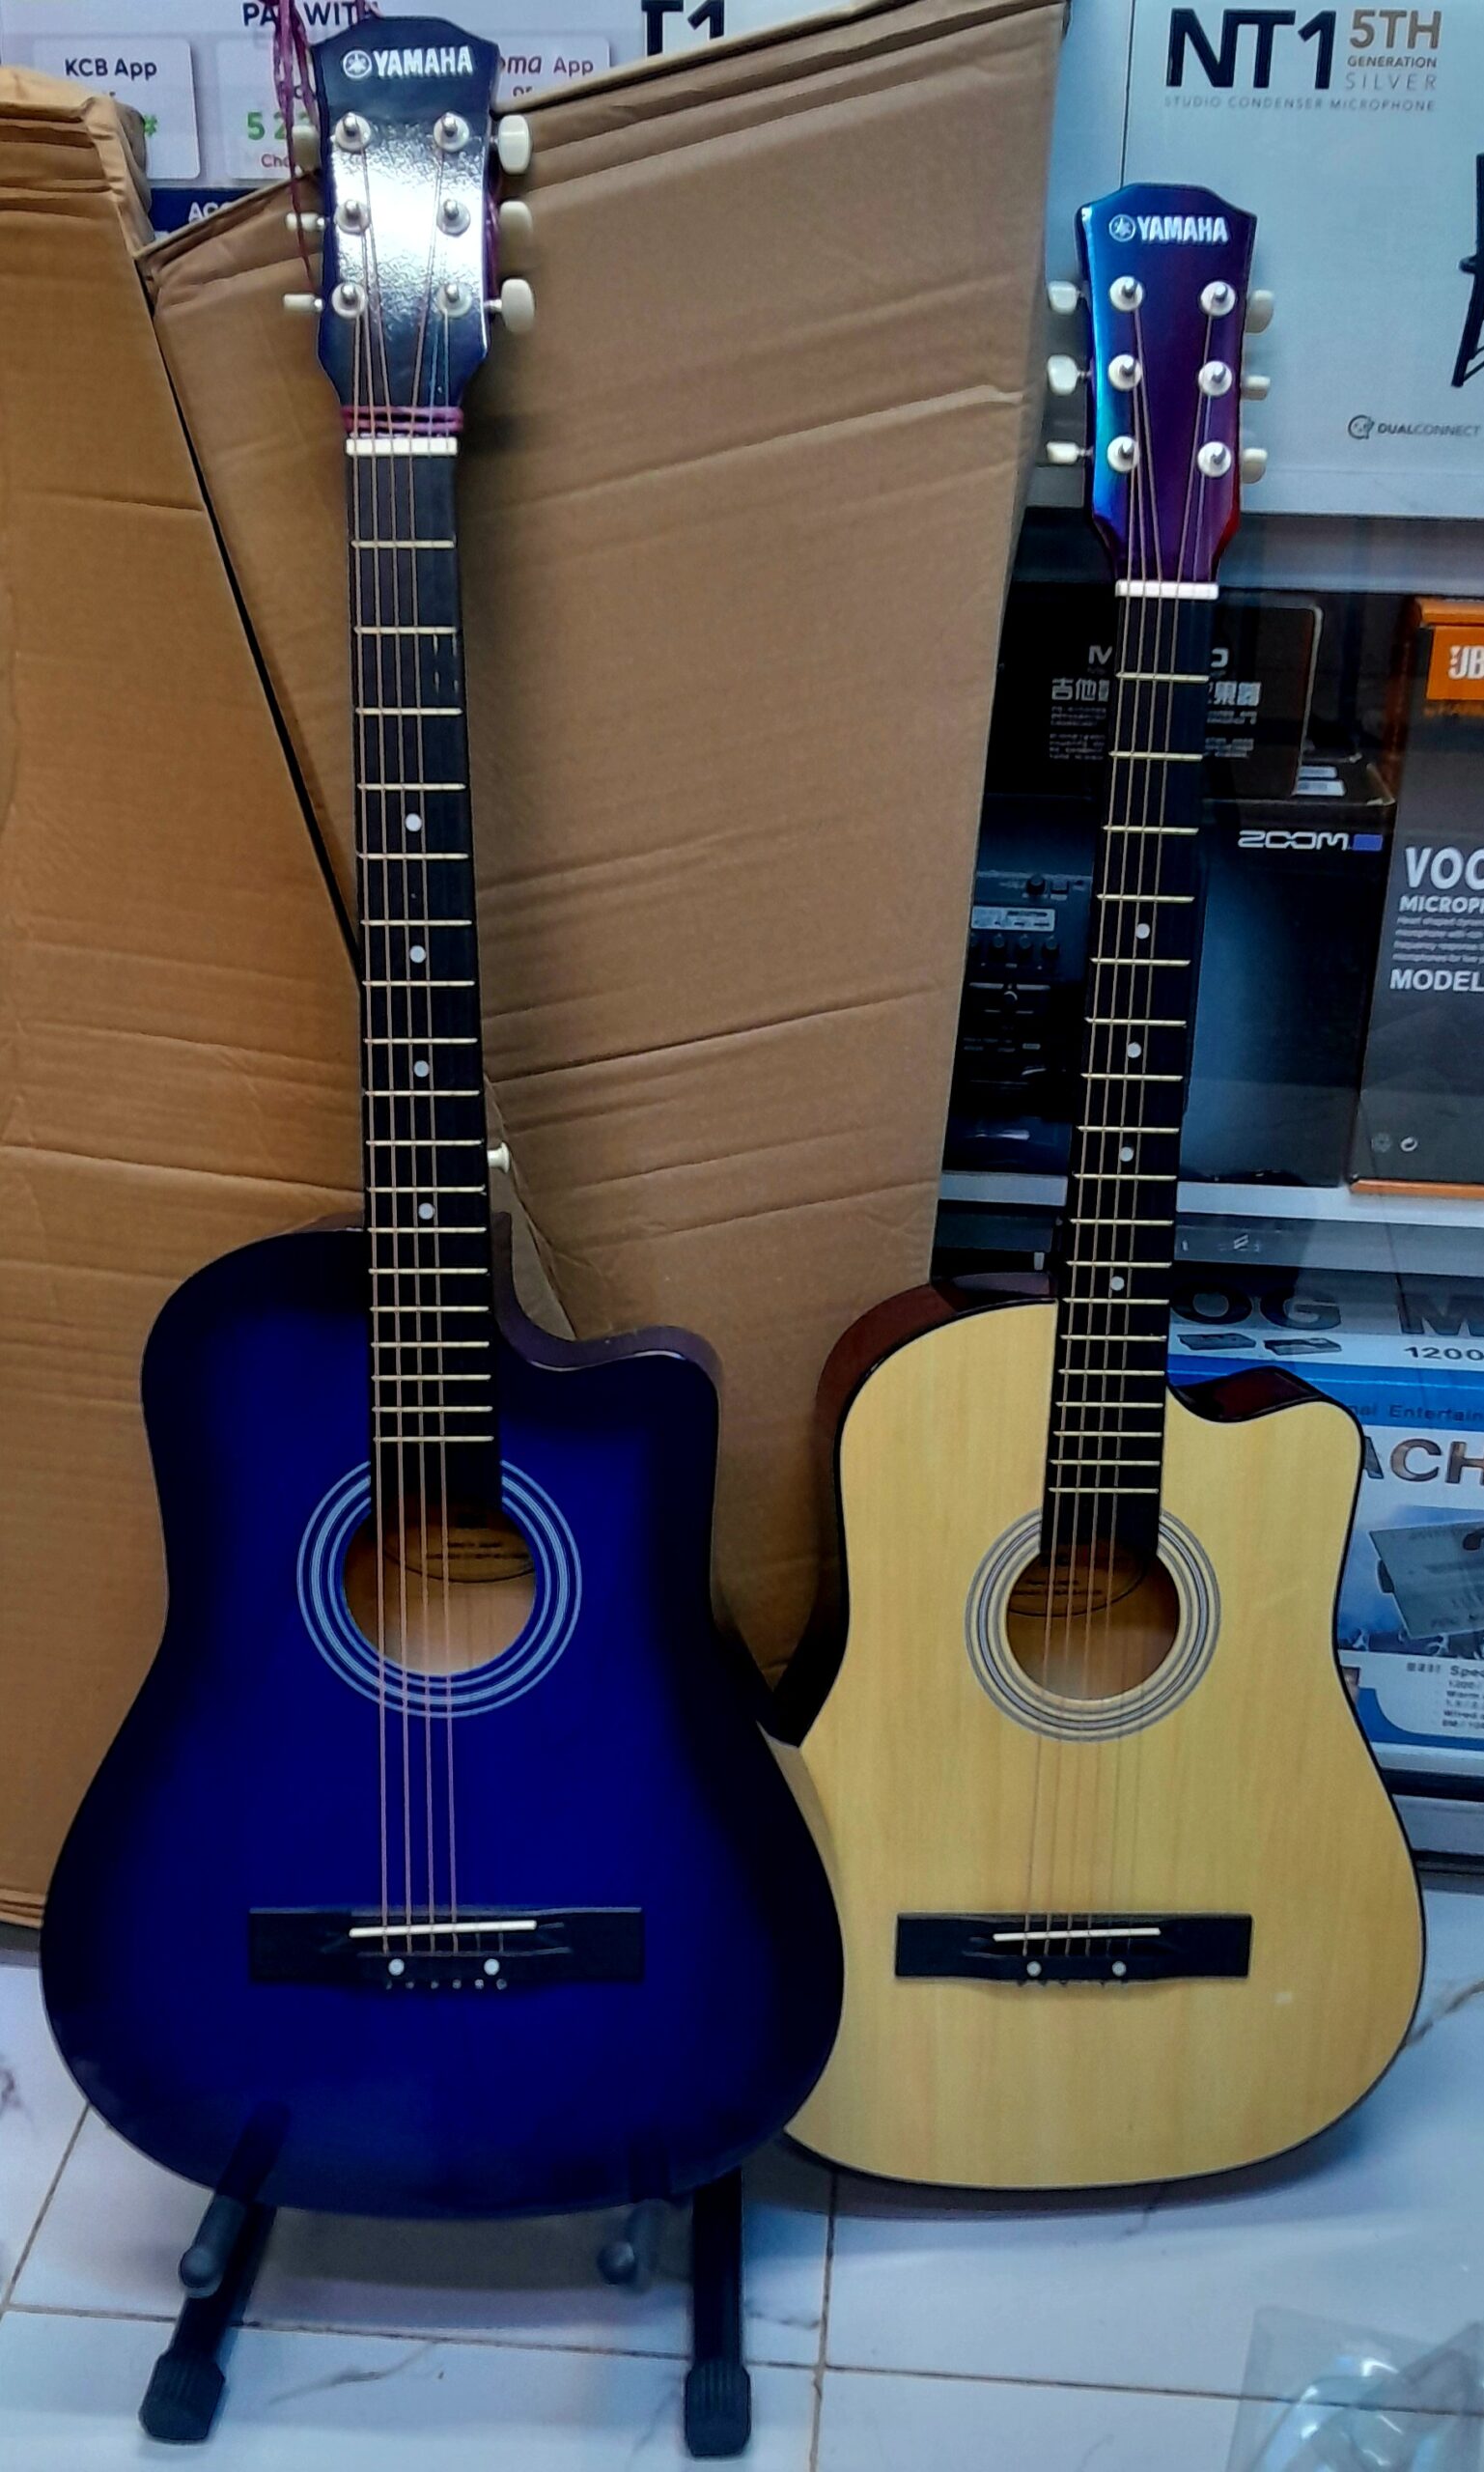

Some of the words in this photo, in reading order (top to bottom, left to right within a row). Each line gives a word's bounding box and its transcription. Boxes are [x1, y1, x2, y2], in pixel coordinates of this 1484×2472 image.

[242, 2, 288, 26] PA
[303, 1, 371, 26] WIT
[1350, 9, 1442, 49] 5TH
[1165, 8, 1336, 89] NT1
[65, 58, 107, 76] KCB
[114, 58, 157, 80] App
[373, 46, 474, 77] YAMAHA
[553, 57, 594, 77] App
[1347, 56, 1437, 69] GENERATION
[1345, 72, 1437, 91] SILVER
[1164, 96, 1220, 108] STUDIO
[1228, 97, 1323, 110] CONDENSER
[1330, 98, 1435, 112] MICROPHONE
[1136, 215, 1229, 244] YAMAHA
[1377, 422, 1481, 437] DUALCONNECT
[1238, 829, 1349, 851] ZOOM
[1390, 969, 1484, 993] MODEL
